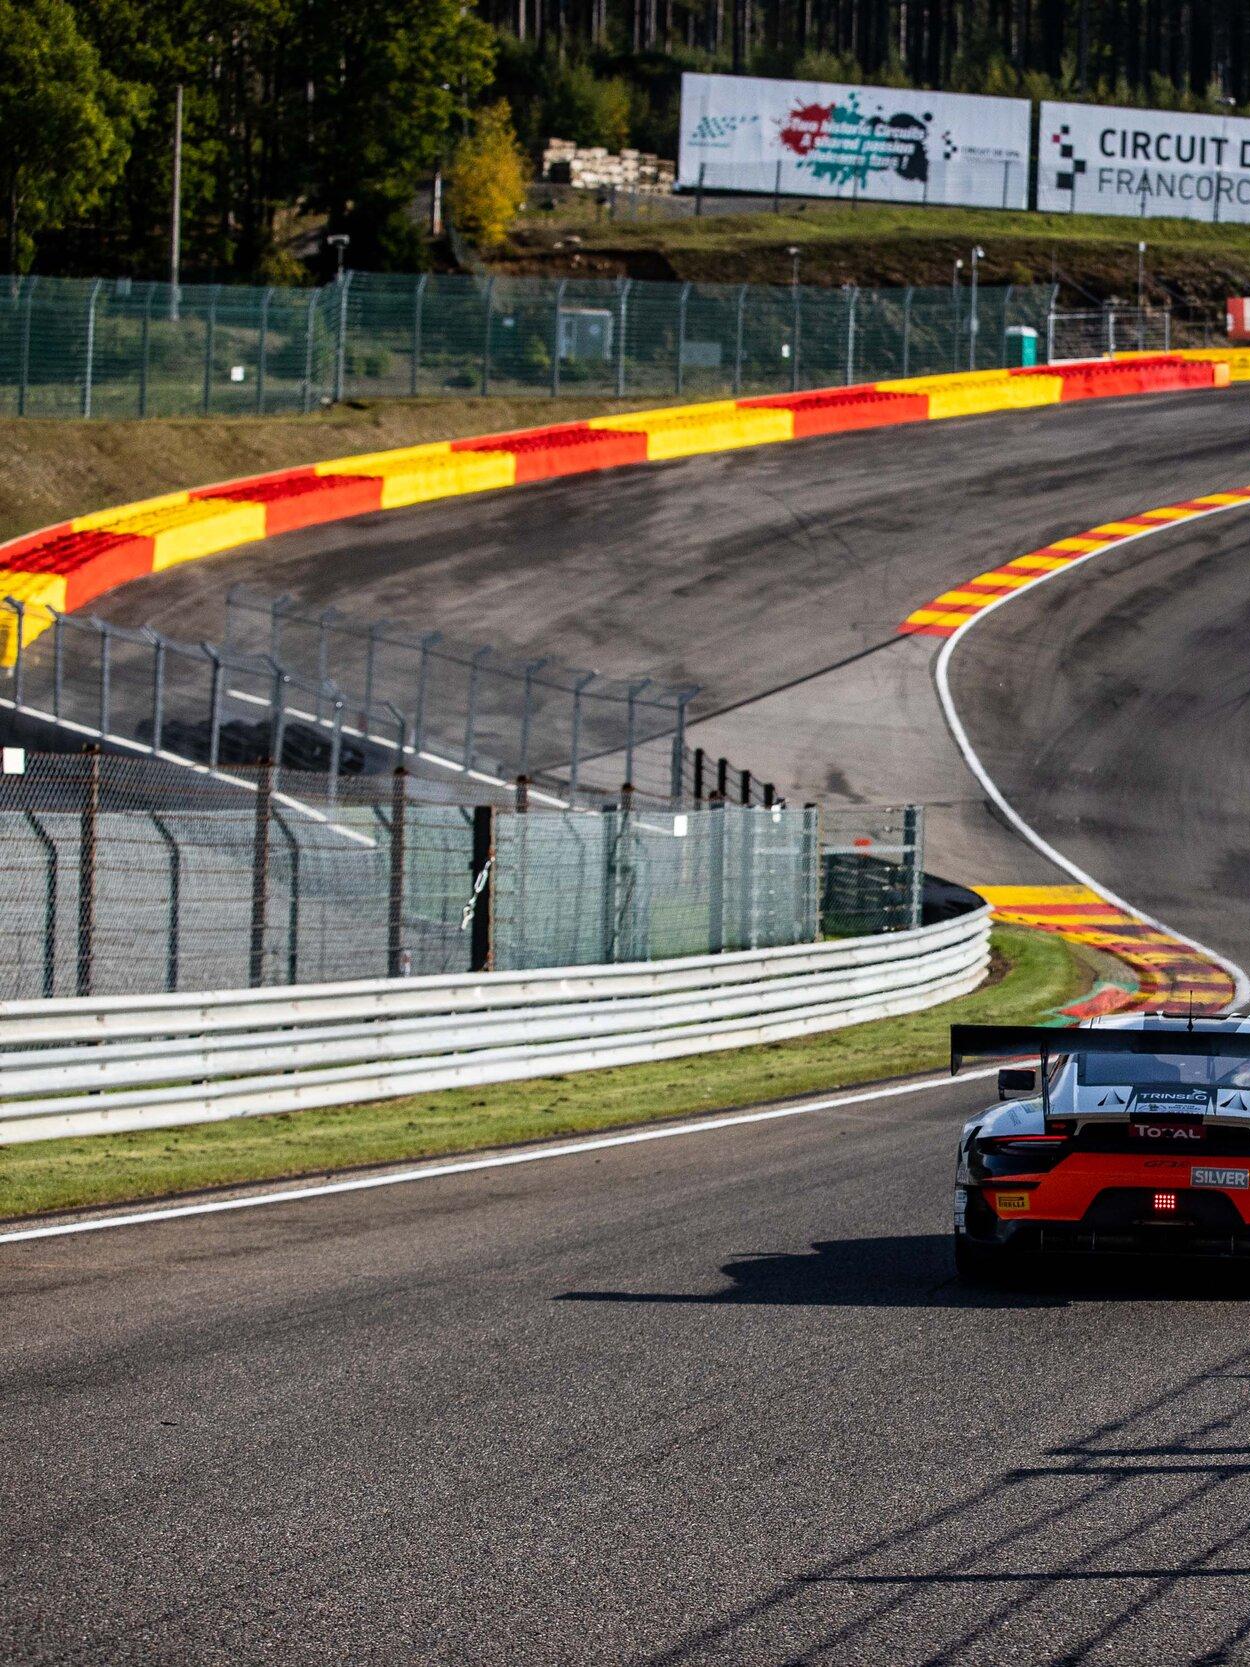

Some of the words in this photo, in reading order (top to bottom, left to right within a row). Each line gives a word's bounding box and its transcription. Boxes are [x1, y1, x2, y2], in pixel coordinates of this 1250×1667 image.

[1100, 128, 1228, 165] CIRCUIT
[1140, 1092, 1207, 1101] TRINSEO
[1195, 1169, 1246, 1186] SILVER
